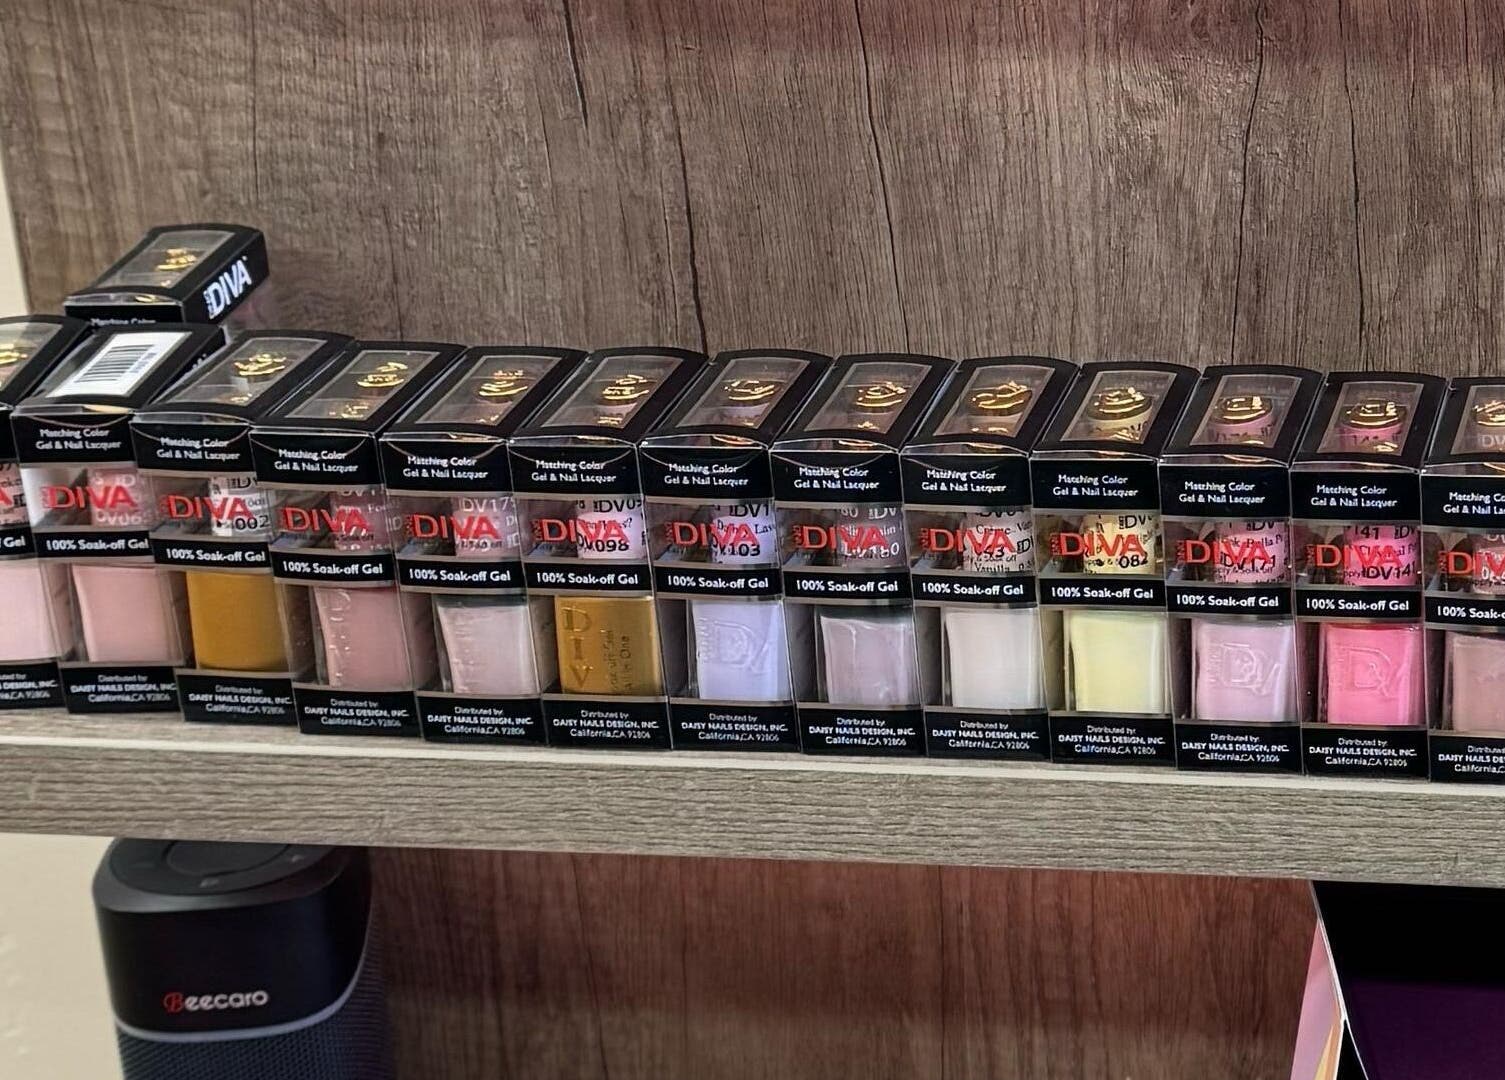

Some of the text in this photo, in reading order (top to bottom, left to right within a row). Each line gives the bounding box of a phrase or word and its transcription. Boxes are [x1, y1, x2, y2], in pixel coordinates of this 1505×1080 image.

[205, 257, 252, 319] DIVA
[1184, 481, 1256, 493] Matching Color
[51, 486, 137, 509] DIVA
[1178, 493, 1266, 505] Gel & Nail Lacquer
[167, 495, 254, 520] DIVA
[286, 507, 369, 532] DIVA
[412, 515, 500, 539] DIVA
[541, 519, 629, 543] DIVA
[674, 522, 759, 546] DIVA
[3, 535, 26, 547] Gel
[46, 538, 149, 551] 100% Soak-off Gel
[802, 526, 888, 550] DIVA
[930, 528, 1016, 553] DIVA
[1059, 533, 1146, 557] DIVA
[166, 548, 266, 562] 100% Soak-off Gel
[1185, 540, 1270, 564] DIVA
[1316, 544, 1402, 567] DIVA
[282, 560, 383, 575] 100% Soak-off Gel
[409, 568, 511, 582] 100% Soak-off Gel
[536, 572, 639, 585] 100% Soak-off Gel
[667, 575, 769, 589] 100% Soak-off Gel
[796, 579, 899, 592] 100% Soak-off Gel
[922, 582, 1024, 596] 100% Soak-off Gel
[1051, 586, 1154, 599] 100% Soak-off Gel
[1176, 594, 1279, 607] 100% Soak-off Gel
[1306, 598, 1410, 611] 100% Soak-off Gel
[1437, 605, 1467, 618] 100%
[163, 989, 269, 1013] Beecaro
